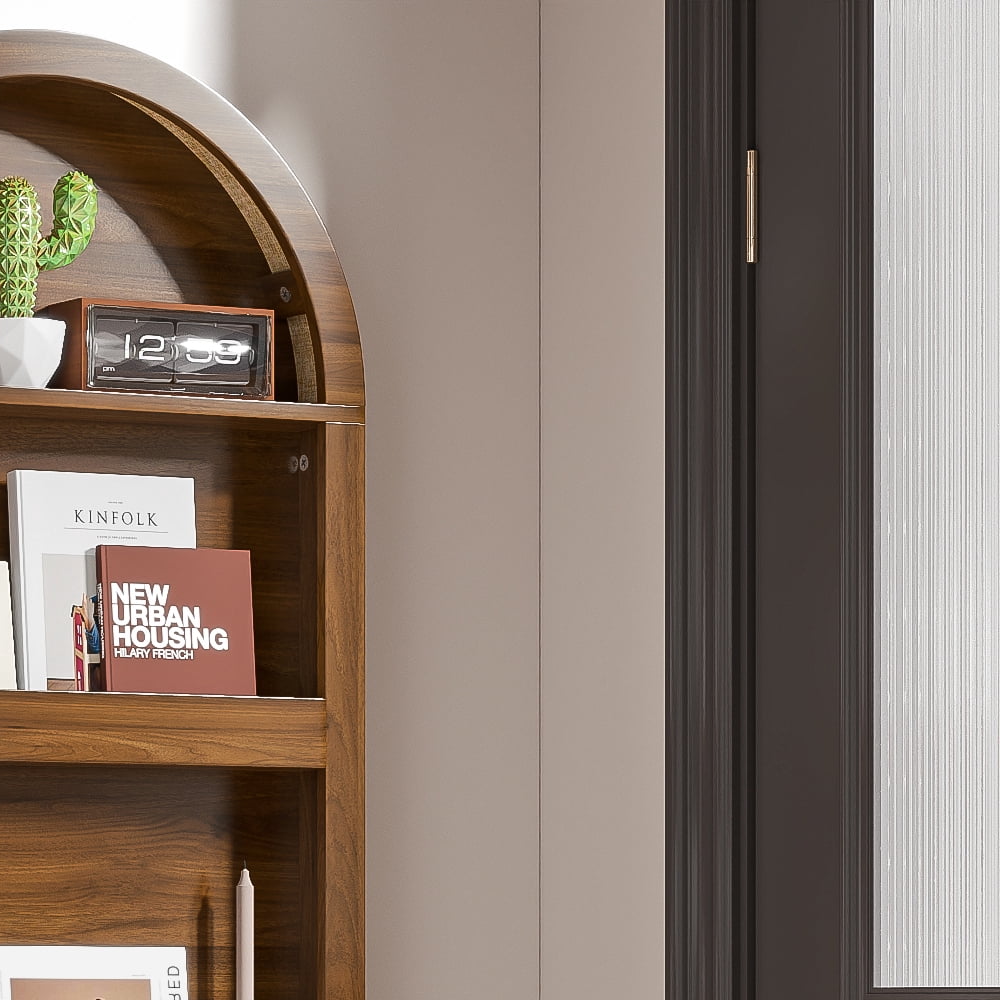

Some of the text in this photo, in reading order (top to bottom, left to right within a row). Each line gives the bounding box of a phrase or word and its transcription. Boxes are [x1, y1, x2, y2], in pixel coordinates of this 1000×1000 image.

[74, 509, 158, 527] KINFOLK
[110, 582, 170, 606] NEW
[111, 603, 201, 628] URBAN
[112, 625, 229, 650] HOUSING
[114, 648, 194, 660] HILARY FRENCH
